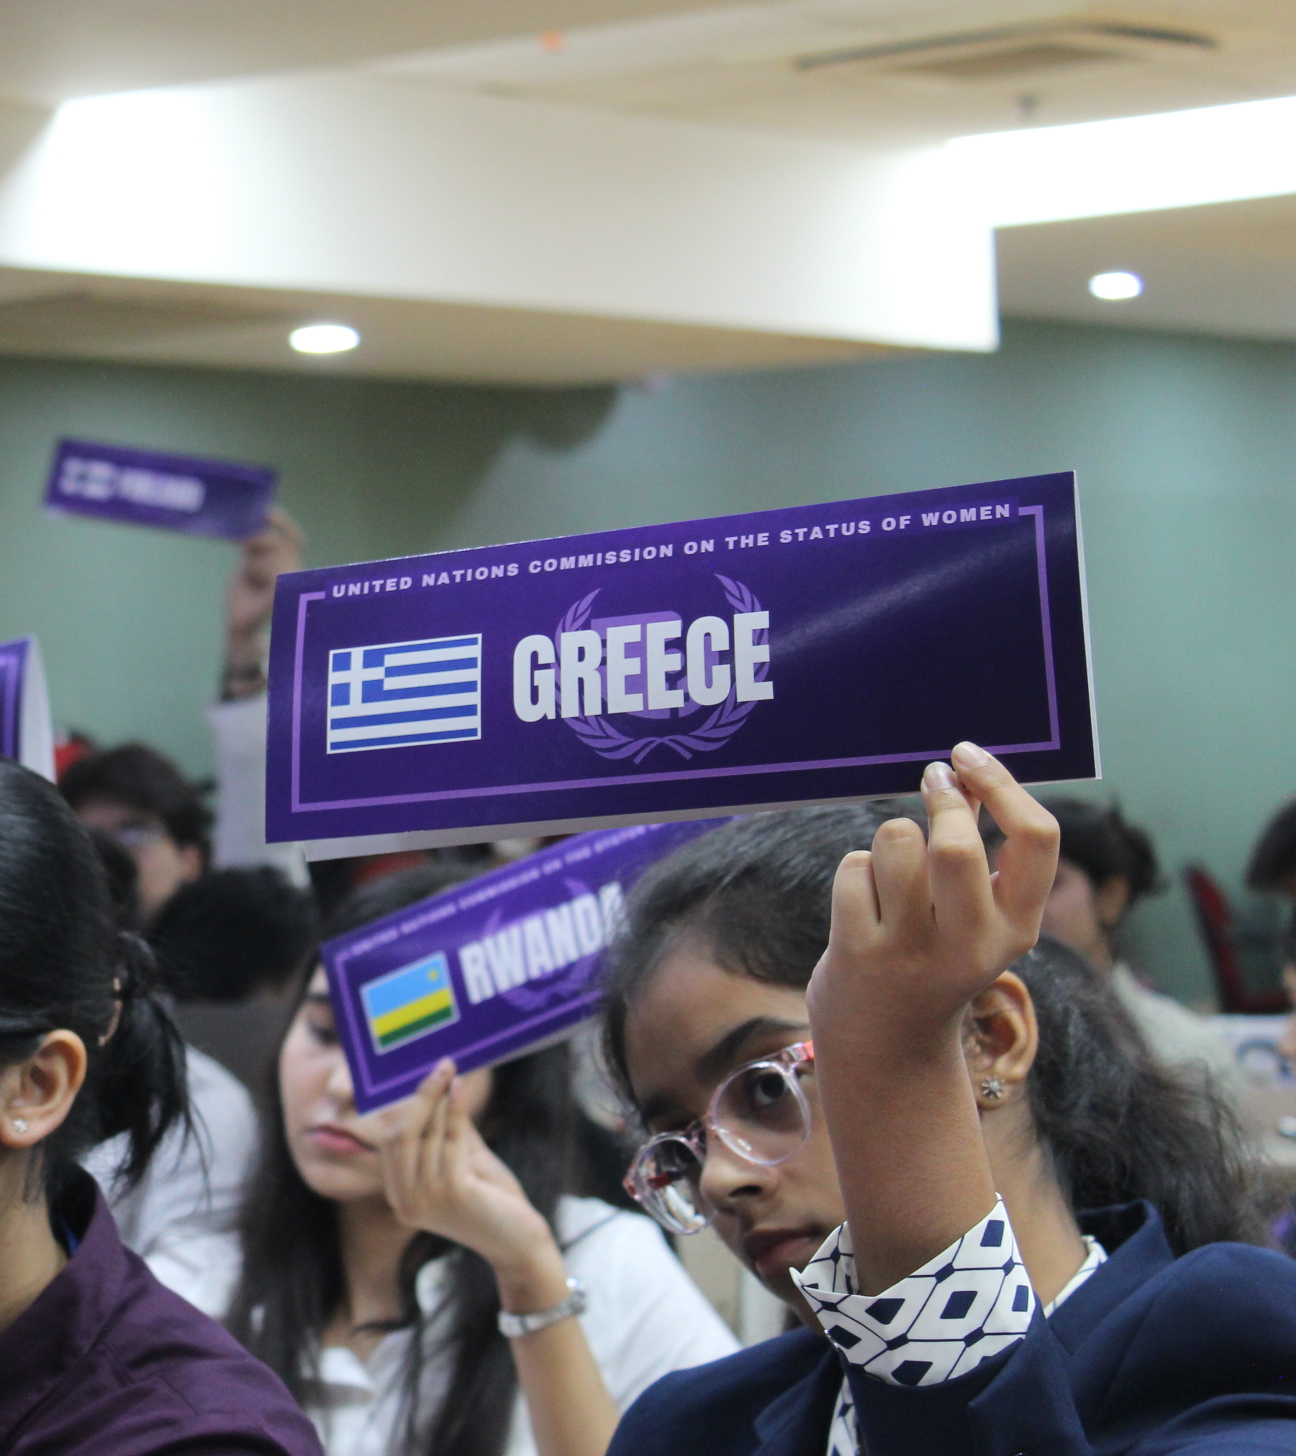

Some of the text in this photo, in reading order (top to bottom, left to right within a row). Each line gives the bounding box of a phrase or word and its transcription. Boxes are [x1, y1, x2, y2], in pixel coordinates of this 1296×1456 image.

[332, 503, 1011, 598] UNITED NATIONS COMMISSION ON THE STATUS OF WOMEN
[512, 610, 774, 722] GREECE
